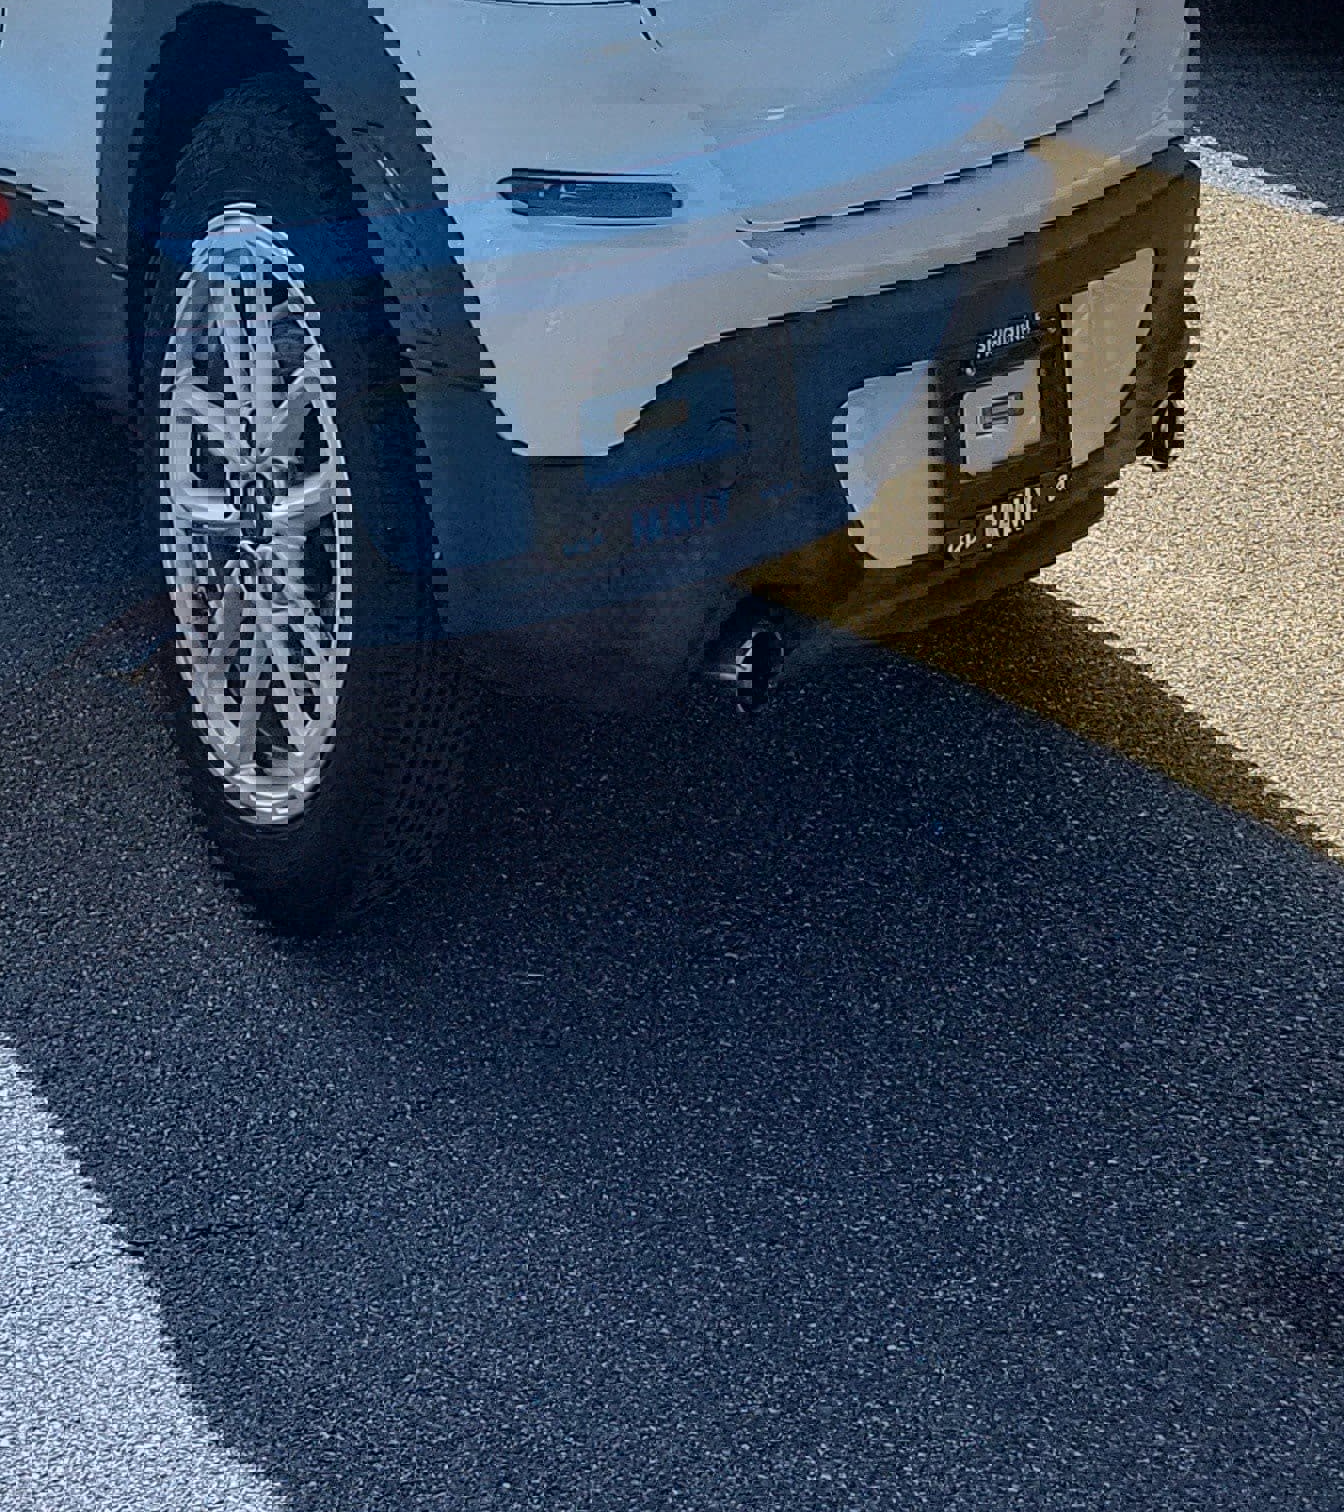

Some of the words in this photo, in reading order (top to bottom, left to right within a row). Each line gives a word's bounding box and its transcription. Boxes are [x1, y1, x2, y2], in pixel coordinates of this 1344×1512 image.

[608, 341, 630, 363] ST.
[632, 322, 712, 358] AUGUSTINE,
[714, 317, 729, 336] FL
[632, 487, 732, 549] FAMILY
